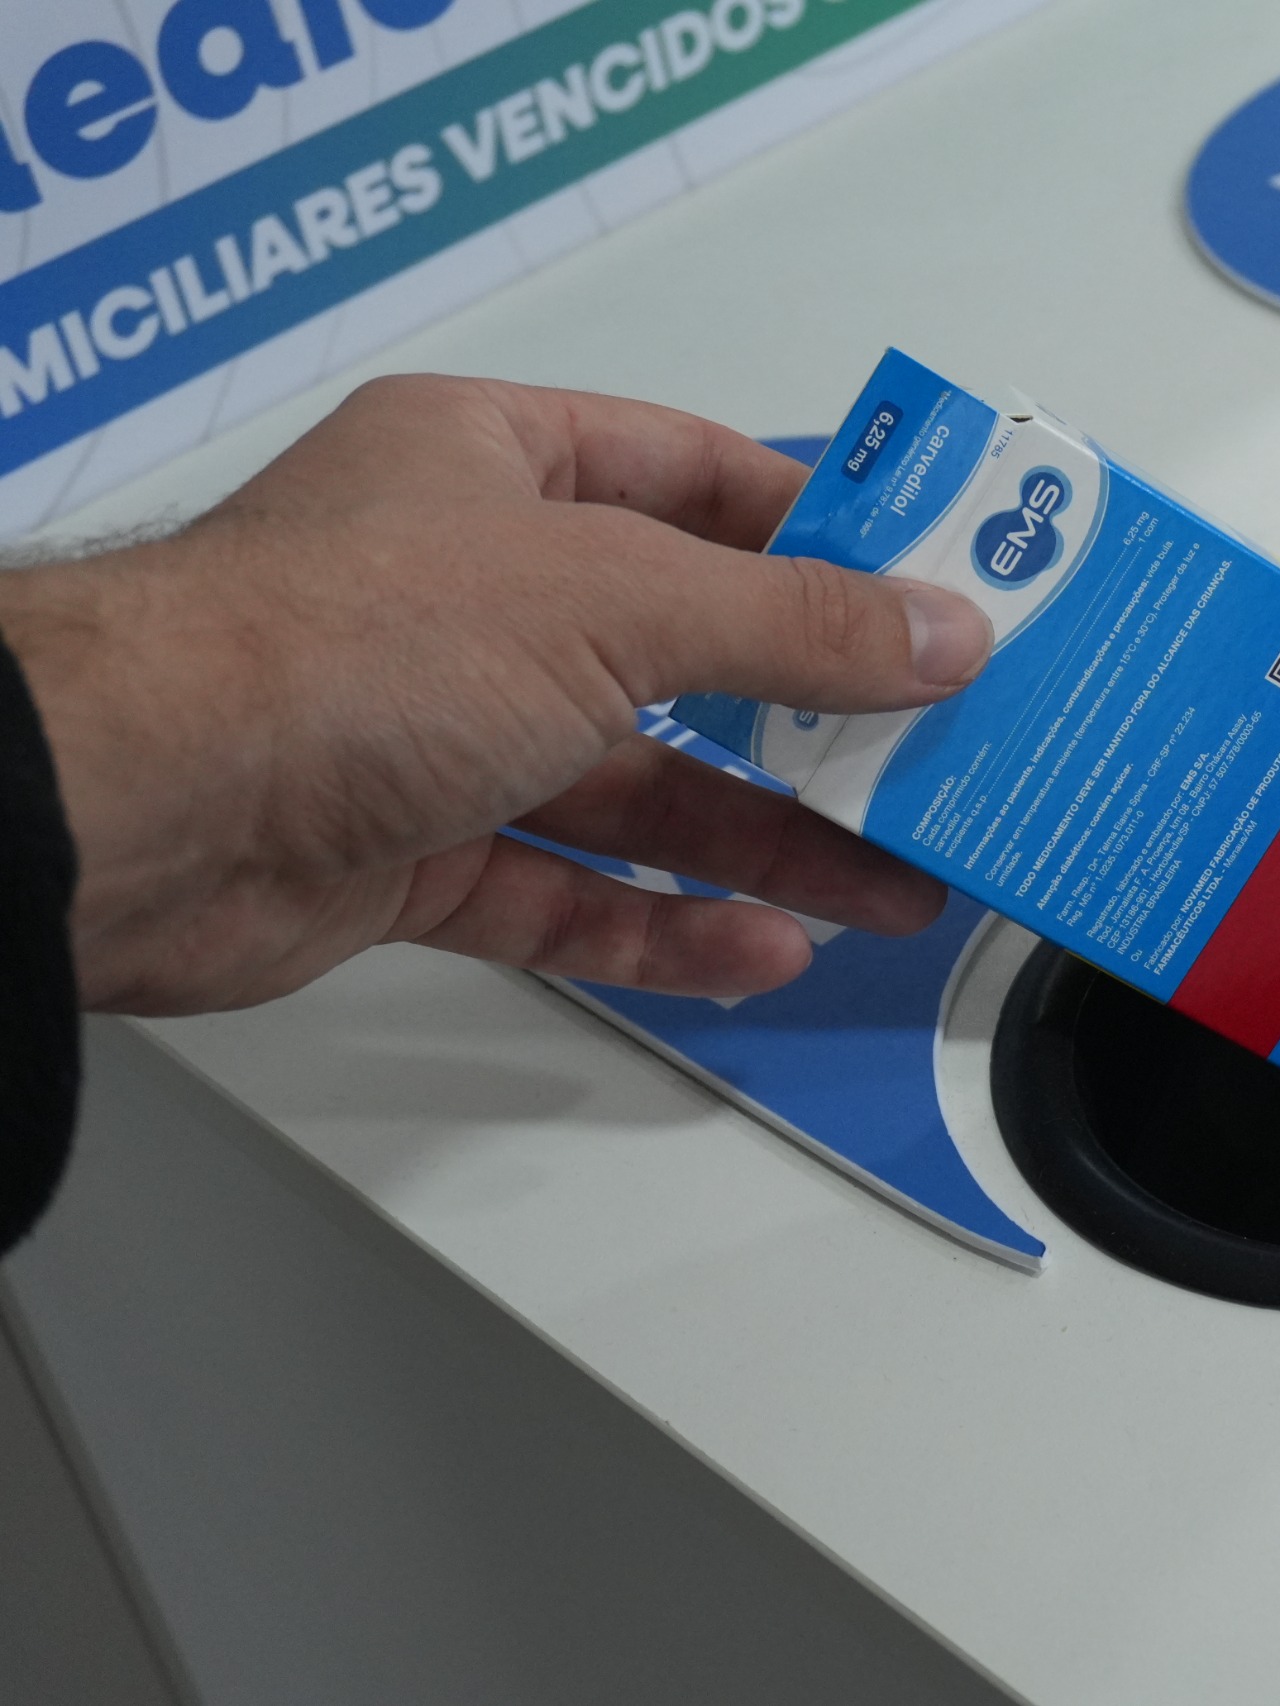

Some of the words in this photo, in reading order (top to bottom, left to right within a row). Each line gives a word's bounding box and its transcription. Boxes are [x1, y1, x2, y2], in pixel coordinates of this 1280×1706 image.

[847, 448, 869, 472] mg
[864, 411, 895, 450] 6,25
[890, 424, 950, 517] carvedilol
[990, 479, 1060, 576] EMS
[933, 812, 961, 852] carvedilol
[1122, 525, 1139, 546] 6,25
[1135, 511, 1150, 526] mg
[944, 816, 974, 858] excipiente
[970, 794, 988, 817] q.s.p.
[1143, 517, 1159, 537] com
[963, 816, 1002, 870] Informações
[999, 803, 1009, 816] ao
[1006, 765, 1036, 804] paciente,
[1062, 639, 1111, 714] contraindicações
[1108, 632, 1116, 640] e
[1112, 578, 1149, 633] precauções:
[1146, 560, 1161, 578] vide
[1156, 540, 1174, 560] bula.
[984, 839, 1015, 881] Conservar
[1012, 825, 1024, 840] em
[1019, 776, 1055, 826] temperatura
[1051, 738, 1078, 777] ambiente
[1107, 665, 1124, 688] entre
[1134, 636, 1141, 644] e
[1152, 574, 1179, 611] Proteger
[1176, 562, 1188, 575] da
[1182, 549, 1196, 563] luz
[1192, 542, 1200, 550] e
[1014, 871, 1036, 897] TODO
[1032, 803, 1079, 871] MEDICAMENTO
[1074, 777, 1096, 803] DEVE
[1090, 758, 1108, 778] SER
[1103, 715, 1134, 759] MANTIDO
[1130, 689, 1151, 716] FORA
[1146, 673, 1160, 689] DO
[1157, 628, 1188, 674] ALCANCE
[1183, 608, 1201, 630] DAS
[1196, 560, 1232, 609] CRIANÇAS.
[911, 775, 956, 840] COMPOSIÇÃO:
[922, 824, 941, 846] Cada
[938, 774, 971, 823] comprimido
[967, 740, 992, 775] contém:
[1036, 874, 1063, 910] Atenção
[1060, 827, 1092, 874] diabéticos:
[1089, 794, 1113, 827] contém
[1110, 763, 1134, 794] açúcar.
[1056, 900, 1075, 921] Farm.
[1097, 831, 1118, 855] Telma
[1112, 806, 1133, 831] Elaine
[1128, 783, 1149, 807] Spina
[1147, 743, 1170, 777] CRF-SP
[1095, 925, 1112, 944] Rod.
[1169, 816, 1182, 829] km
[1178, 803, 1190, 815] 08
[1189, 773, 1209, 798] Bairro
[1205, 739, 1231, 773] Chácara
[1227, 713, 1247, 739] Assay
[1115, 855, 1143, 892] fabricado
[1145, 808, 1173, 848] embalado
[1170, 791, 1182, 809] por:
[1179, 769, 1198, 791] EMS
[996, 851, 1023, 887] umidade.
[1066, 909, 1083, 927] Reg.
[1078, 893, 1092, 907] MS
[1106, 930, 1120, 949] CEP
[1149, 821, 1190, 882] Hortolândia/SP
[1191, 790, 1212, 817] CNPJ:
[1116, 909, 1150, 955] INDÚSTRIA
[1145, 859, 1182, 909] BRASILEIRA
[1143, 931, 1172, 970] Fabricado
[1170, 913, 1182, 931] por:
[1179, 868, 1213, 913] NOVAMED
[1208, 810, 1250, 868] FABRICAÇÃO
[1245, 795, 1259, 811] DE
[1153, 900, 1206, 976] FARMACÊUTICOS
[1202, 875, 1223, 900] LTDA.
[1222, 819, 1257, 868] Manaus/AM
[1130, 949, 1143, 962] Ou
